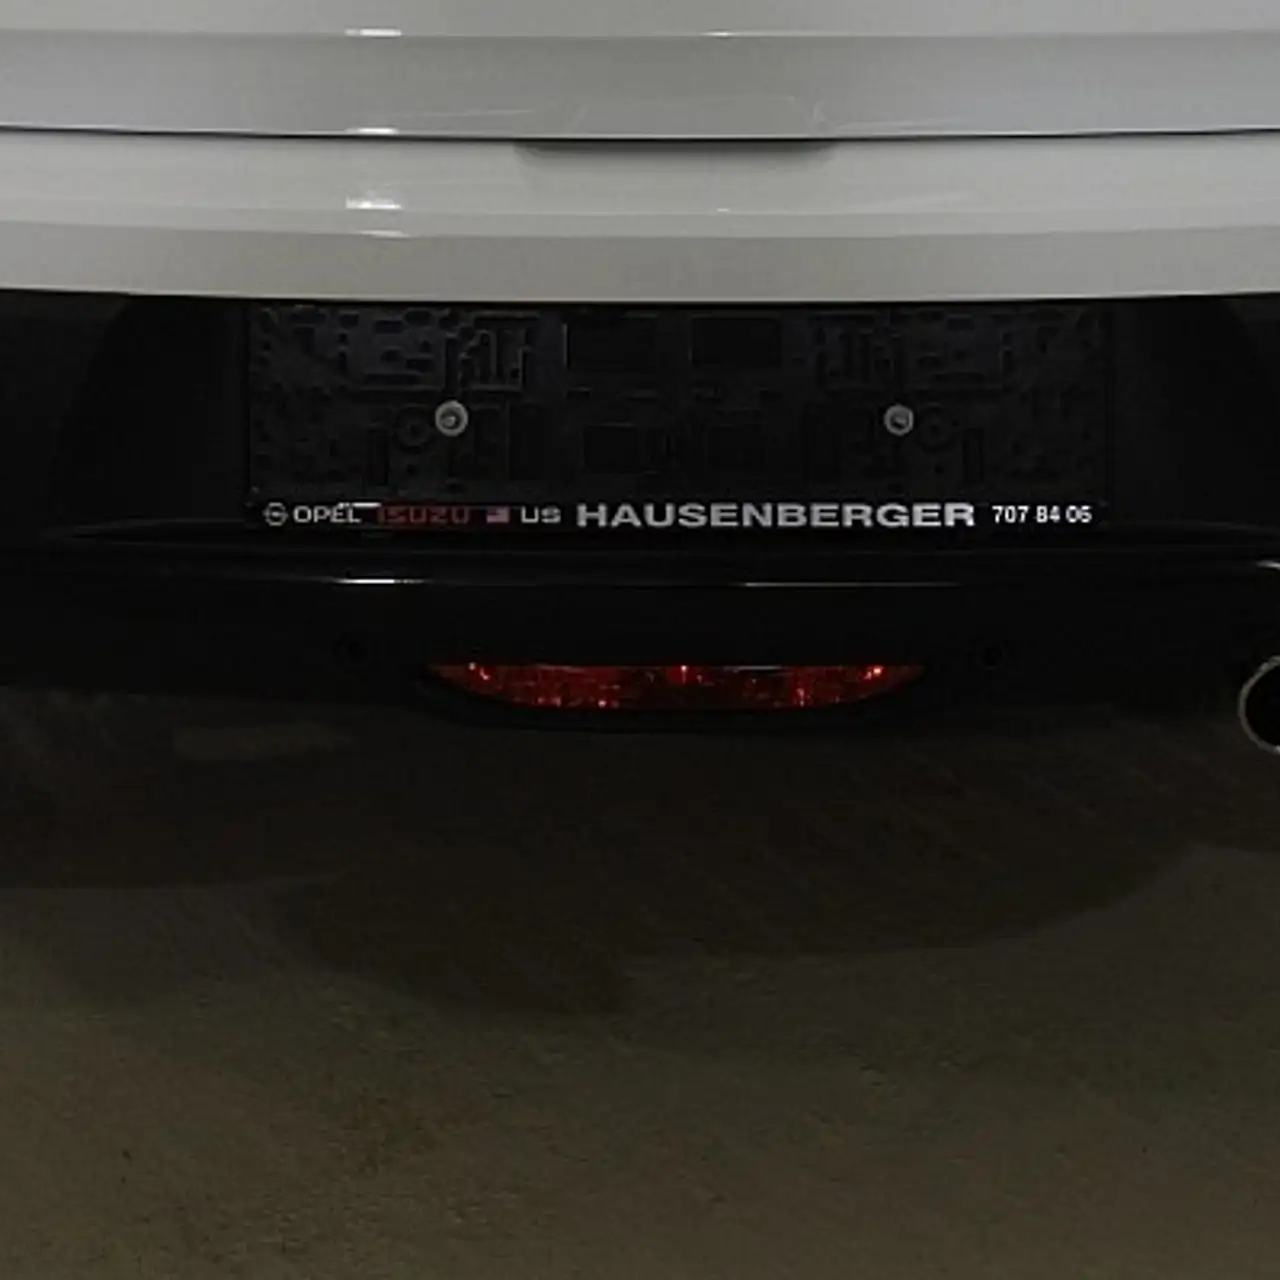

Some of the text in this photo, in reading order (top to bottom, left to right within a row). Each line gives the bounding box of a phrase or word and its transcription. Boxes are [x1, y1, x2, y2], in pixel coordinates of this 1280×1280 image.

[293, 502, 1093, 528] OPEL ISUZU US HAUSENBERGER 707 84 06
